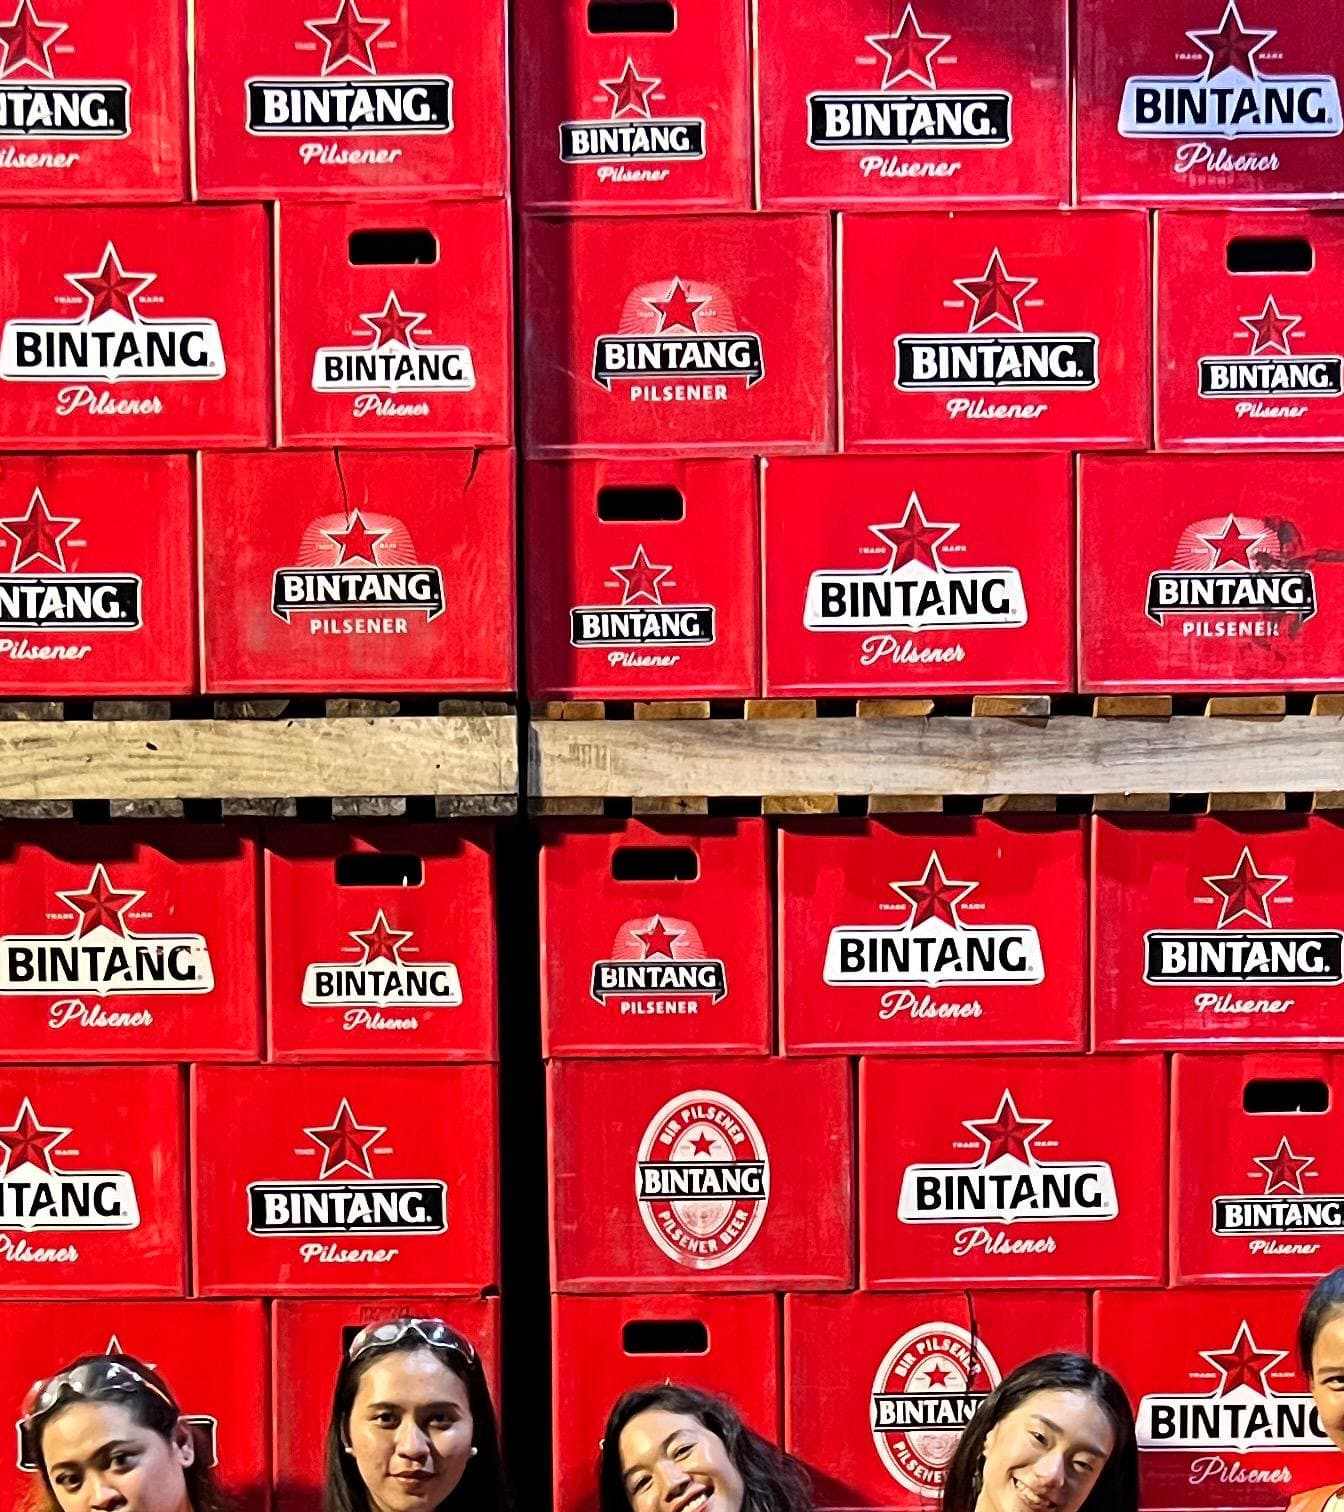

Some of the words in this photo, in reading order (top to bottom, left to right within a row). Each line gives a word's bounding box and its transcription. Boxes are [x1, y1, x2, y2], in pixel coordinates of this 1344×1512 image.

[1135, 88, 1326, 125] BINTANG
[859, 155, 961, 177] Pilsener
[1175, 141, 1281, 172] Pilsener
[15, 331, 209, 368] BINTANG
[631, 384, 727, 400] PILSENER
[1235, 402, 1308, 418] Pilsener
[820, 581, 1011, 618] BINTANG
[310, 617, 408, 634] PILSENER
[9, 946, 196, 982] BINTANG
[840, 937, 1027, 973] BINTANG
[342, 1008, 419, 1030] Pilsener
[620, 1001, 698, 1014] PILSENER
[659, 1119, 682, 1145] BIR
[681, 1105, 745, 1145] PILSENER
[645, 1168, 760, 1194] BINTANG
[915, 1174, 1102, 1210] BINTANG
[658, 1210, 718, 1253] PILSENER
[719, 1209, 749, 1244] BEER
[894, 1353, 917, 1377] BIR
[879, 1399, 985, 1425] BINTAN
[1152, 1404, 1326, 1439] BINTANG
[893, 1441, 947, 1484] PILSENE
